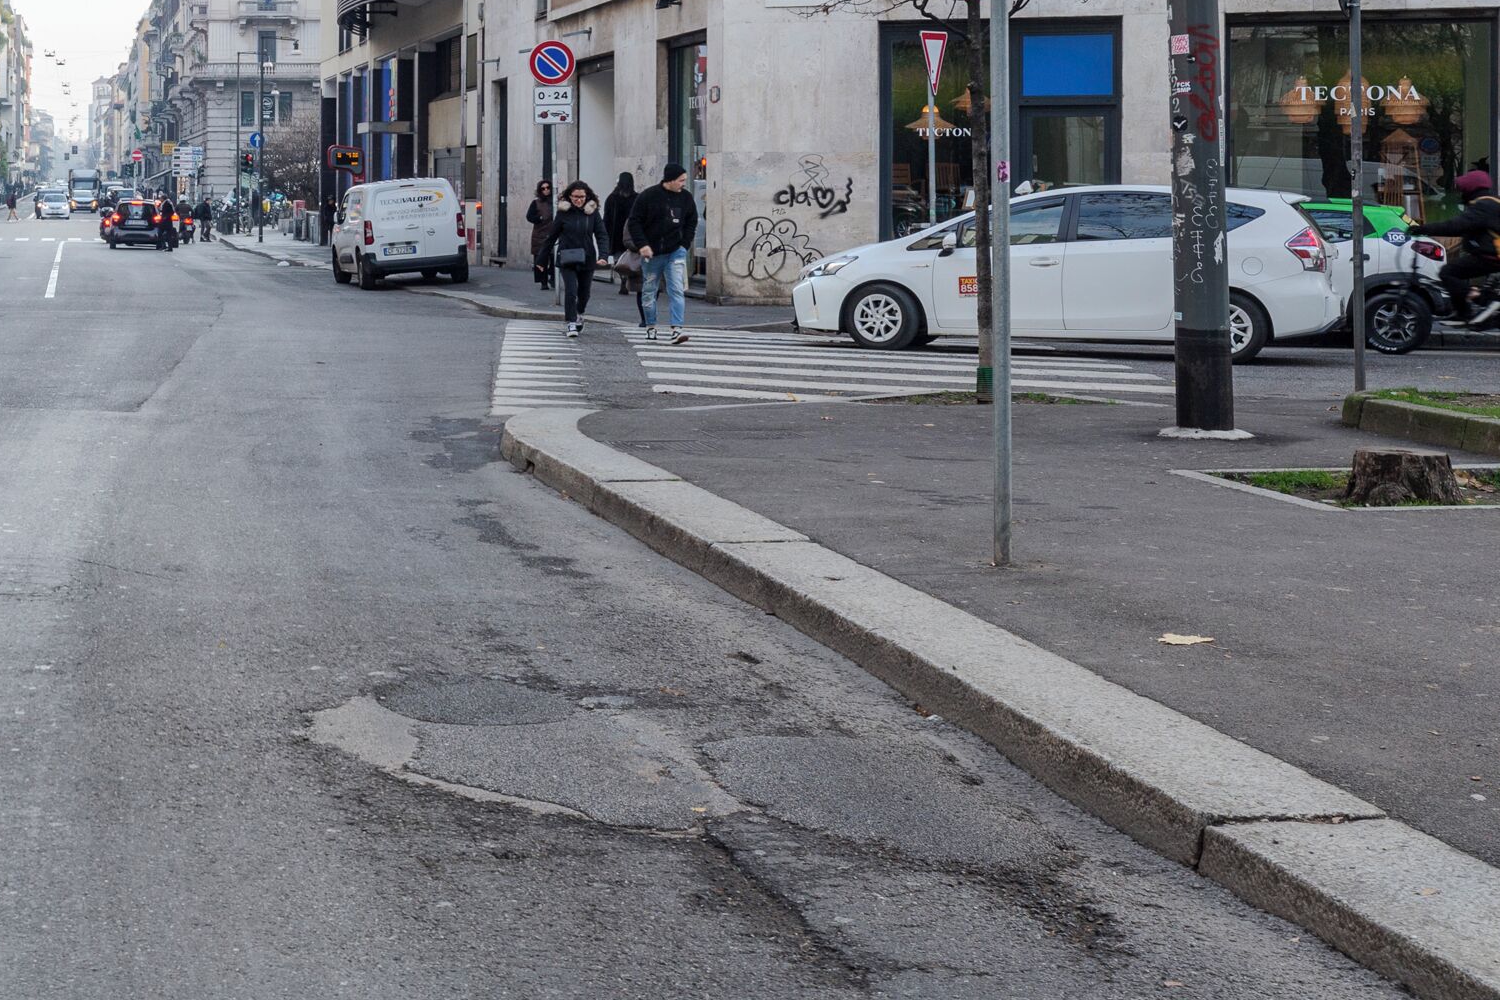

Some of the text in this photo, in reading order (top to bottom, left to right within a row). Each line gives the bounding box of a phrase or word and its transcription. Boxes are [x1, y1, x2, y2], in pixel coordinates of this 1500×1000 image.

[553, 91, 568, 100] 24
[1296, 85, 1421, 101] TECONA
[380, 195, 434, 206] TECNOVALORE
